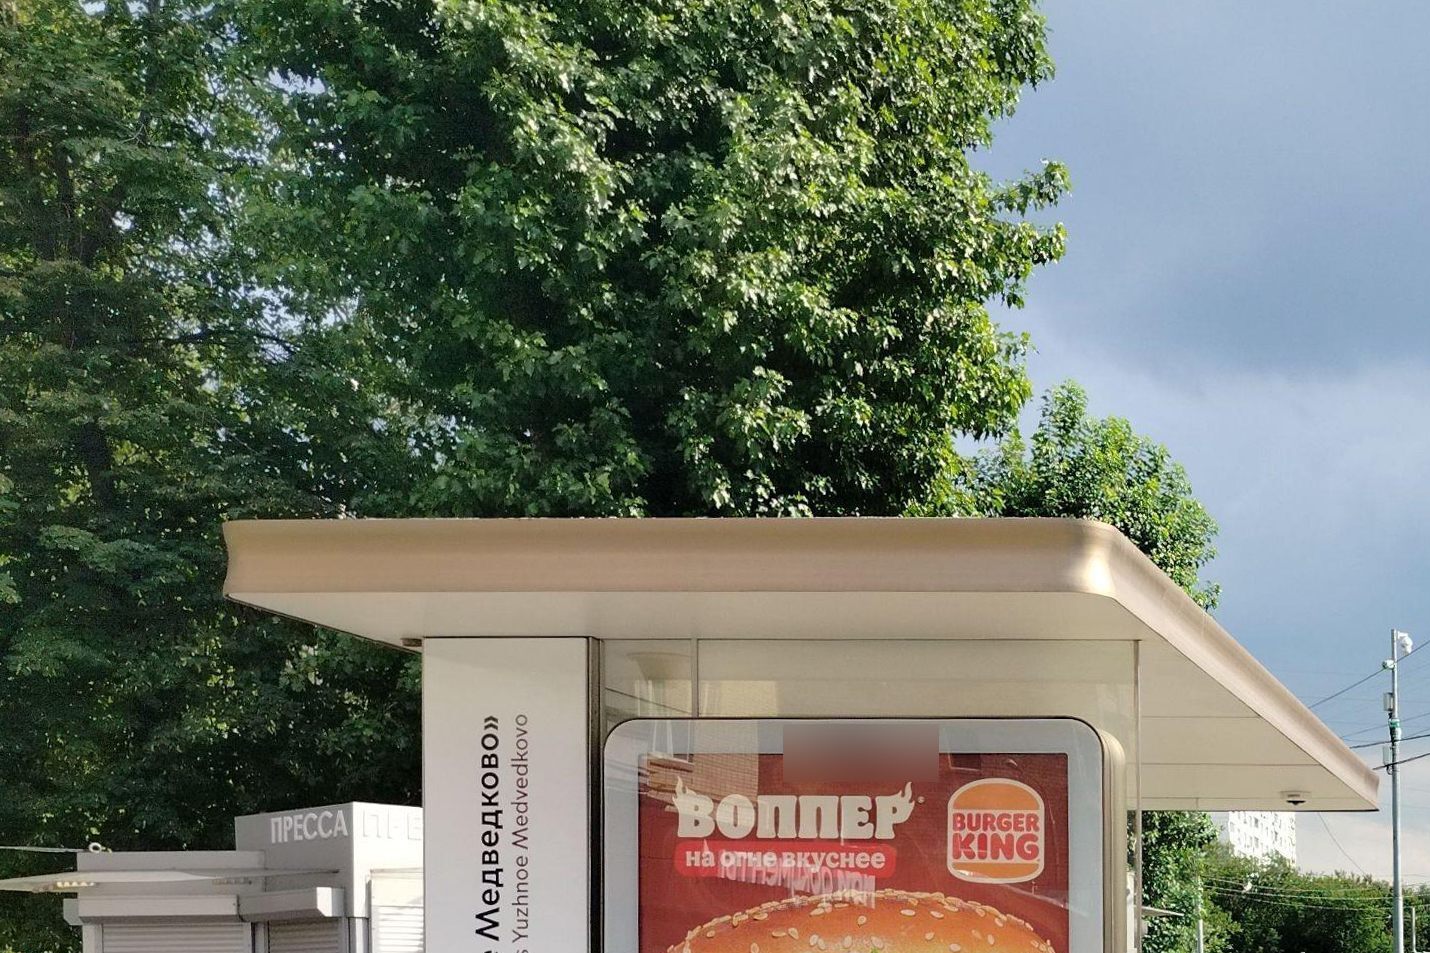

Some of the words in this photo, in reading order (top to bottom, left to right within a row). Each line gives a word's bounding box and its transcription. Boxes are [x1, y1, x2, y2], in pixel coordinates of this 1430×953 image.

[510, 714, 529, 850] Medvedkovo
[271, 810, 348, 844] ПРЕССА
[475, 715, 504, 942] Медведково»
[672, 777, 915, 840] ВОППЕР
[952, 812, 1040, 832] BURGER
[686, 850, 716, 867] на
[720, 850, 778, 869] огне
[781, 851, 886, 873] вкуснее
[952, 832, 1040, 861] KING
[512, 855, 529, 943] Yuzhnoe
